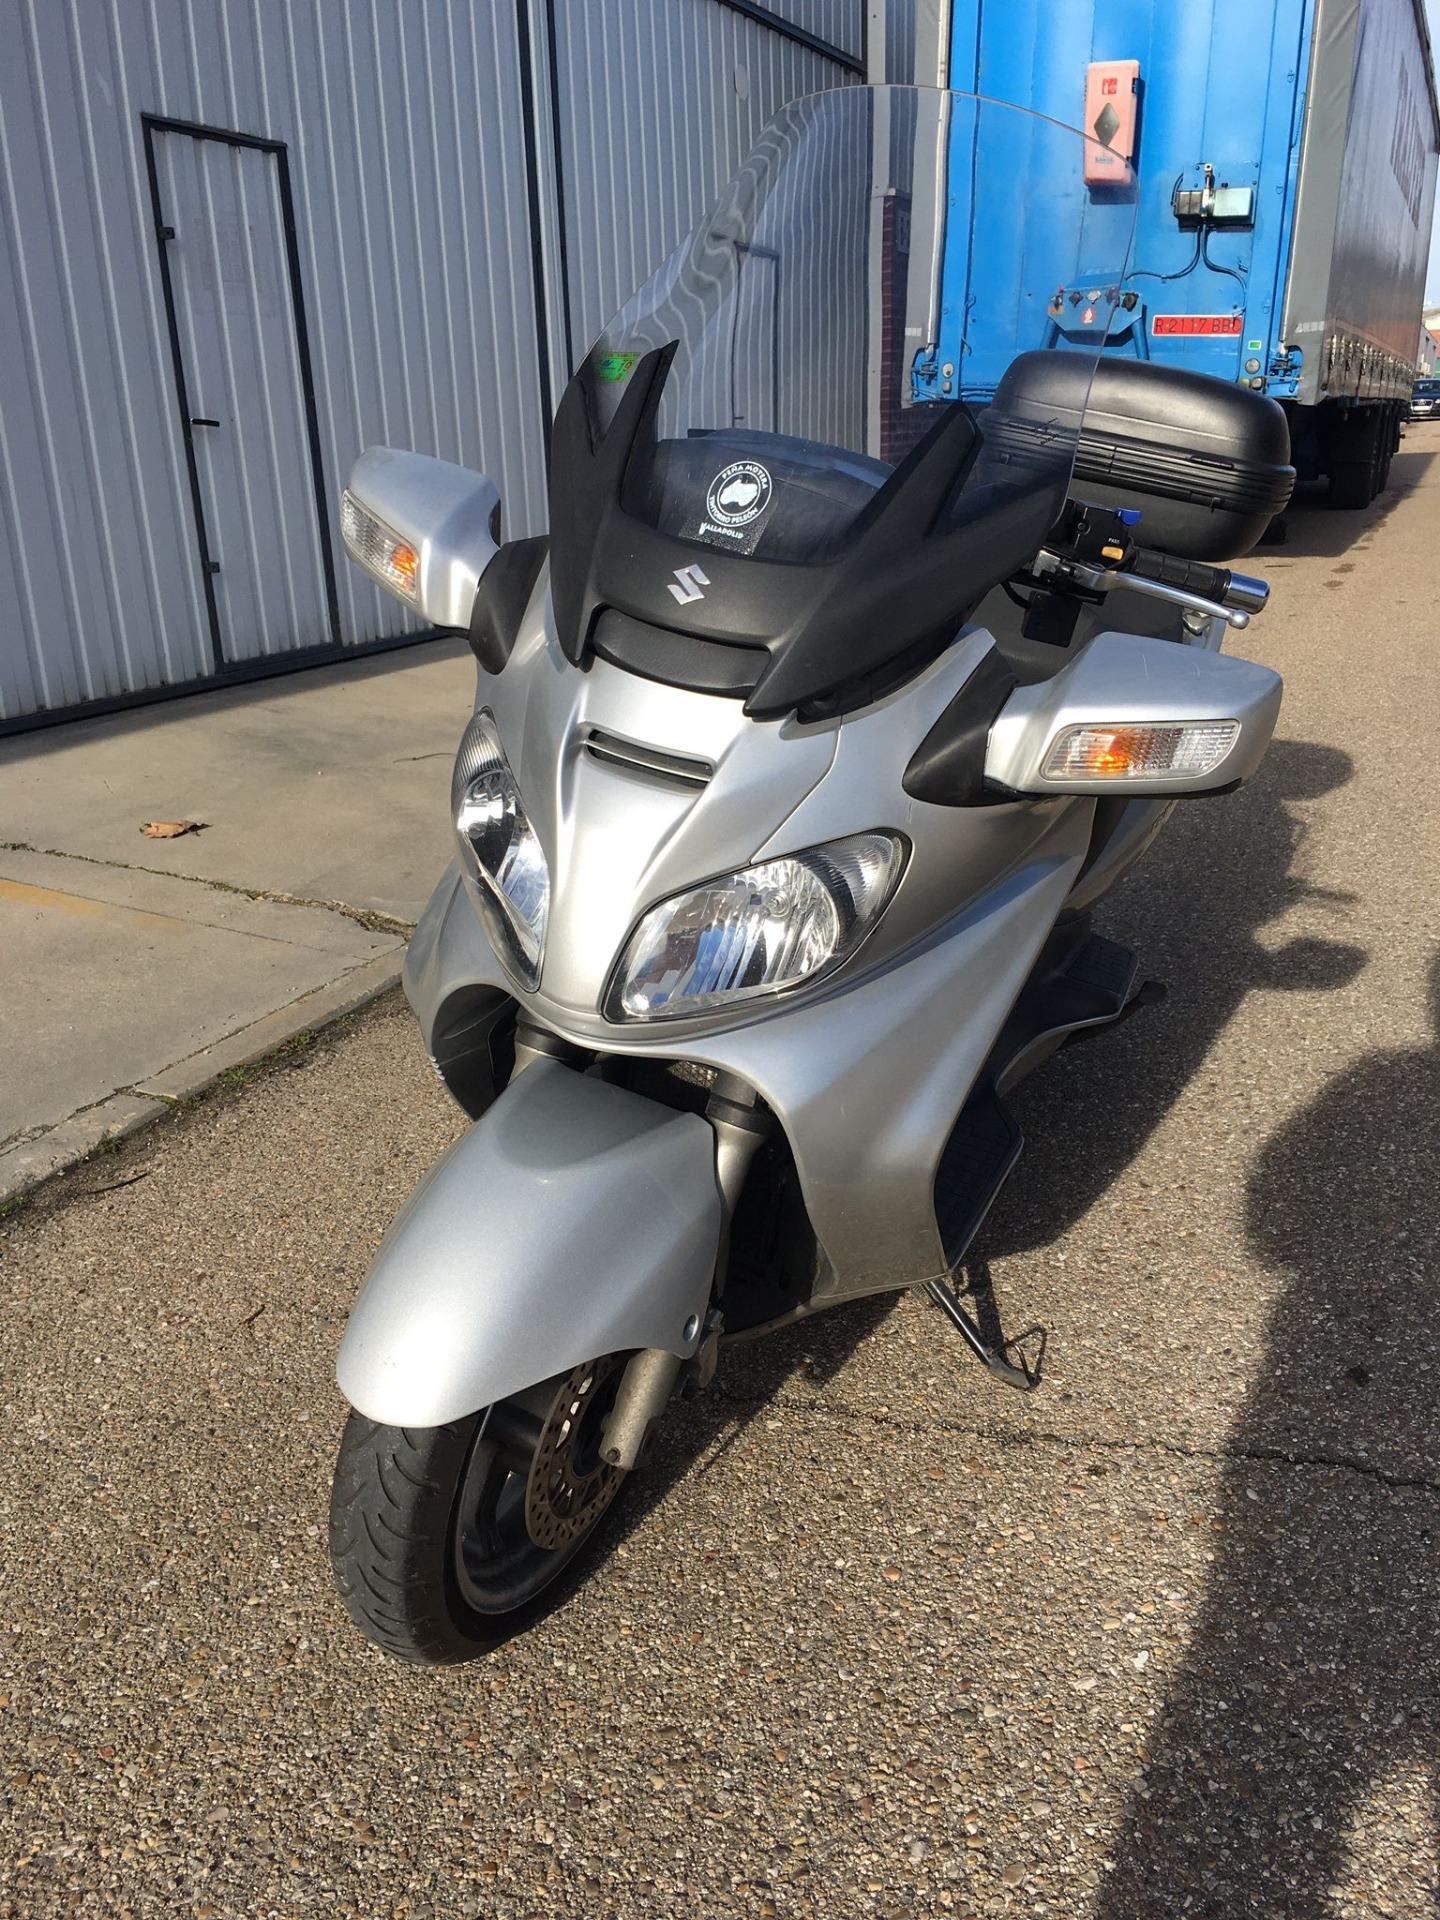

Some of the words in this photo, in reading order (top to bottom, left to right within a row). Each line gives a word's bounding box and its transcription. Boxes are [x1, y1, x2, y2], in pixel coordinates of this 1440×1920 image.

[1168, 318, 1208, 334] 2117
[744, 464, 768, 489] MOTERA
[698, 522, 744, 539] VALLADOLID
